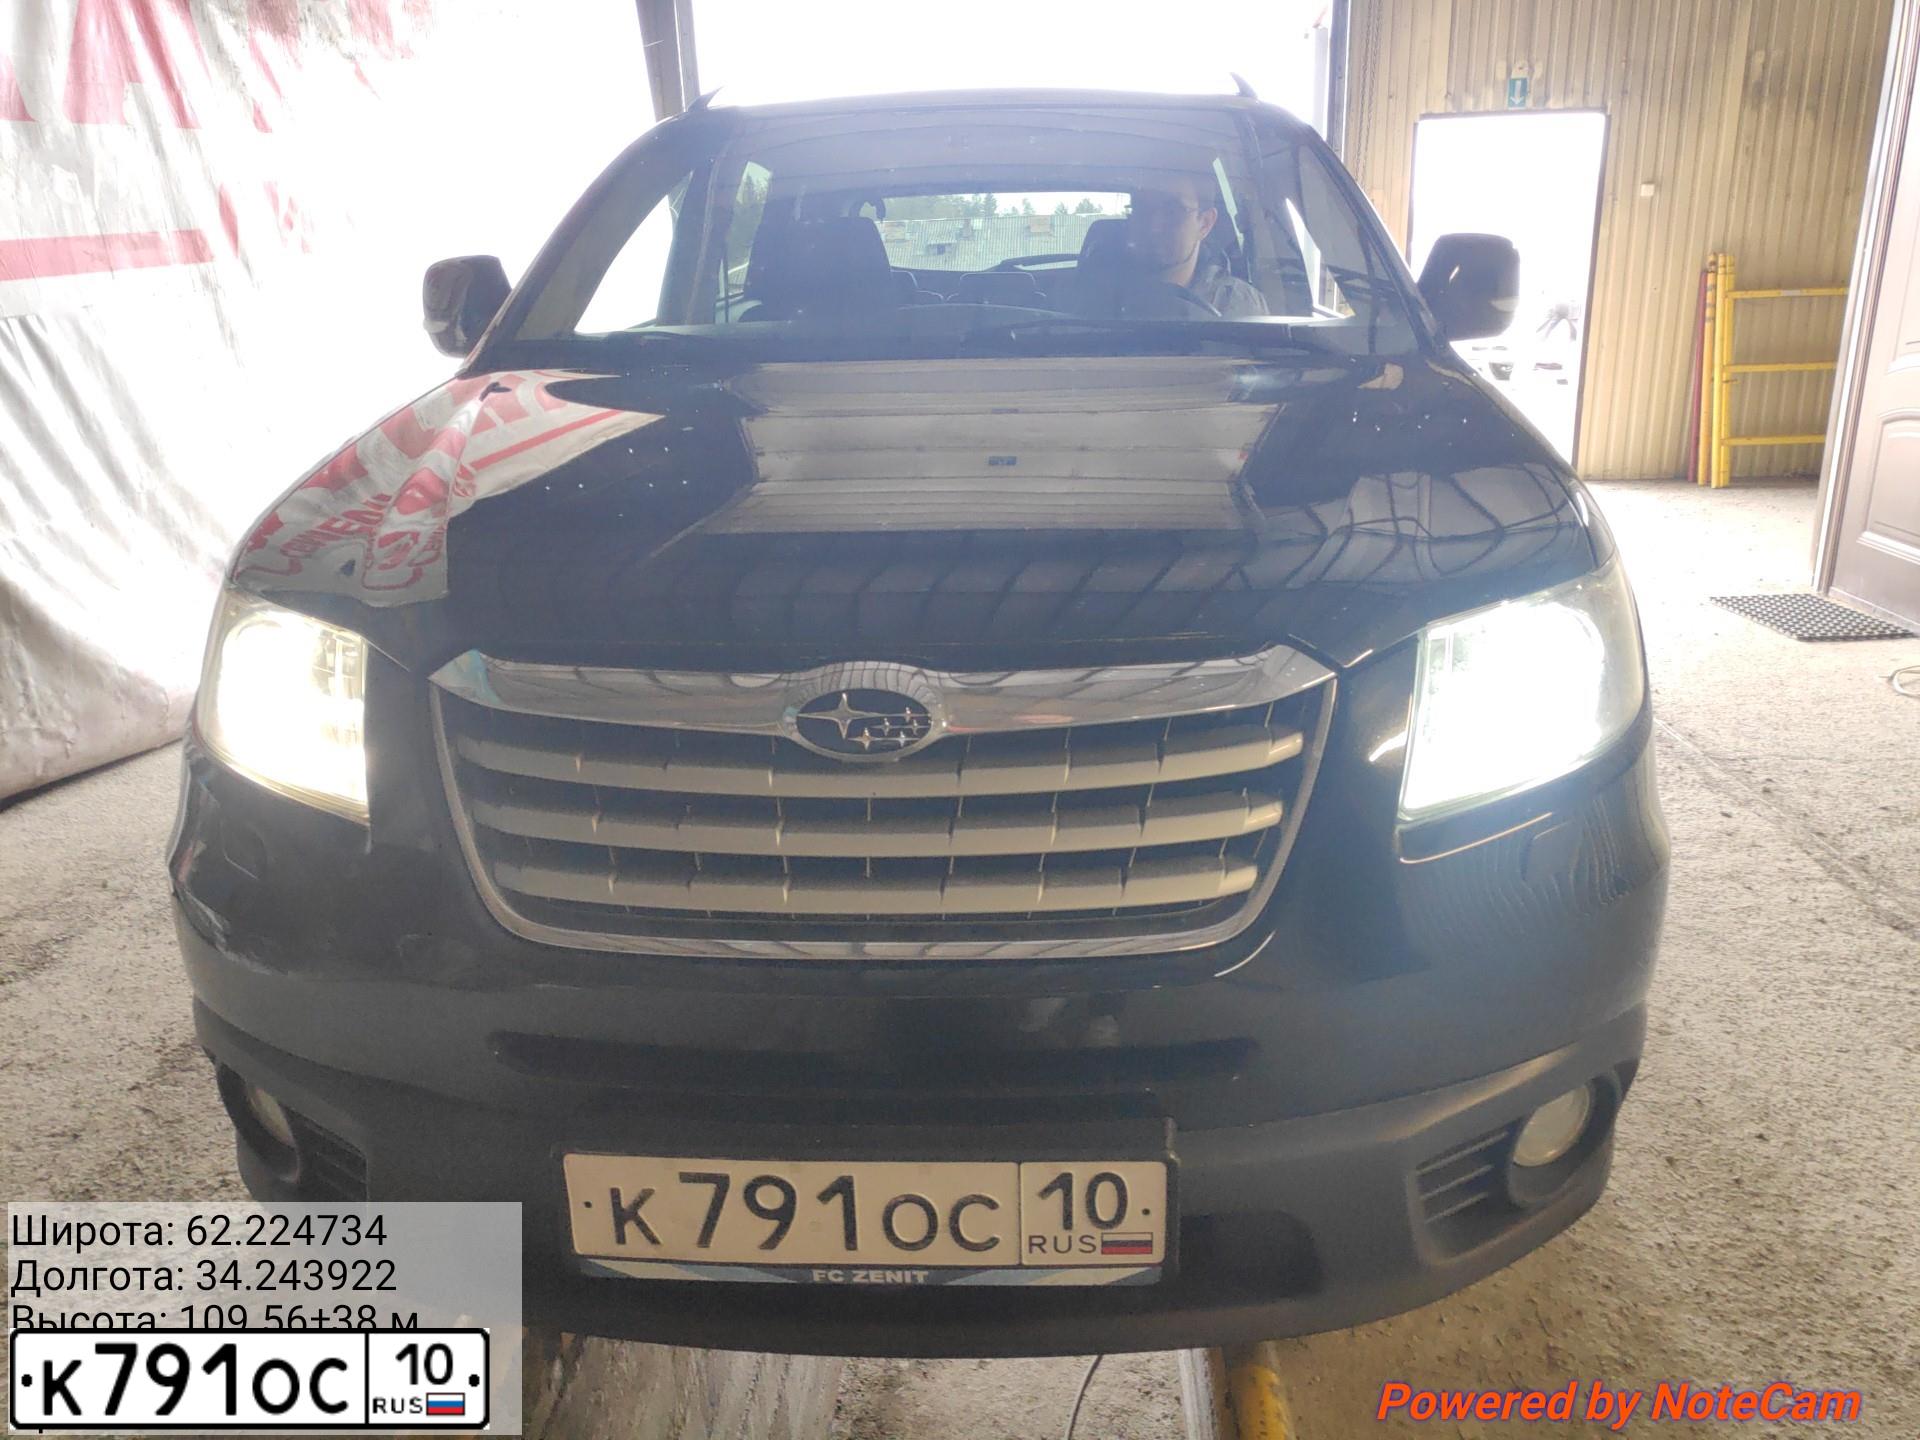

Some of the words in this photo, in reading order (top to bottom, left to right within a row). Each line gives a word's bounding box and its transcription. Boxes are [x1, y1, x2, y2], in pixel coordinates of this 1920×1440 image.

[1038, 1172, 1128, 1230] 10
[1028, 1235, 1097, 1254] RUS
[812, 1269, 843, 1283] FC
[852, 1270, 928, 1284] ZENIT
